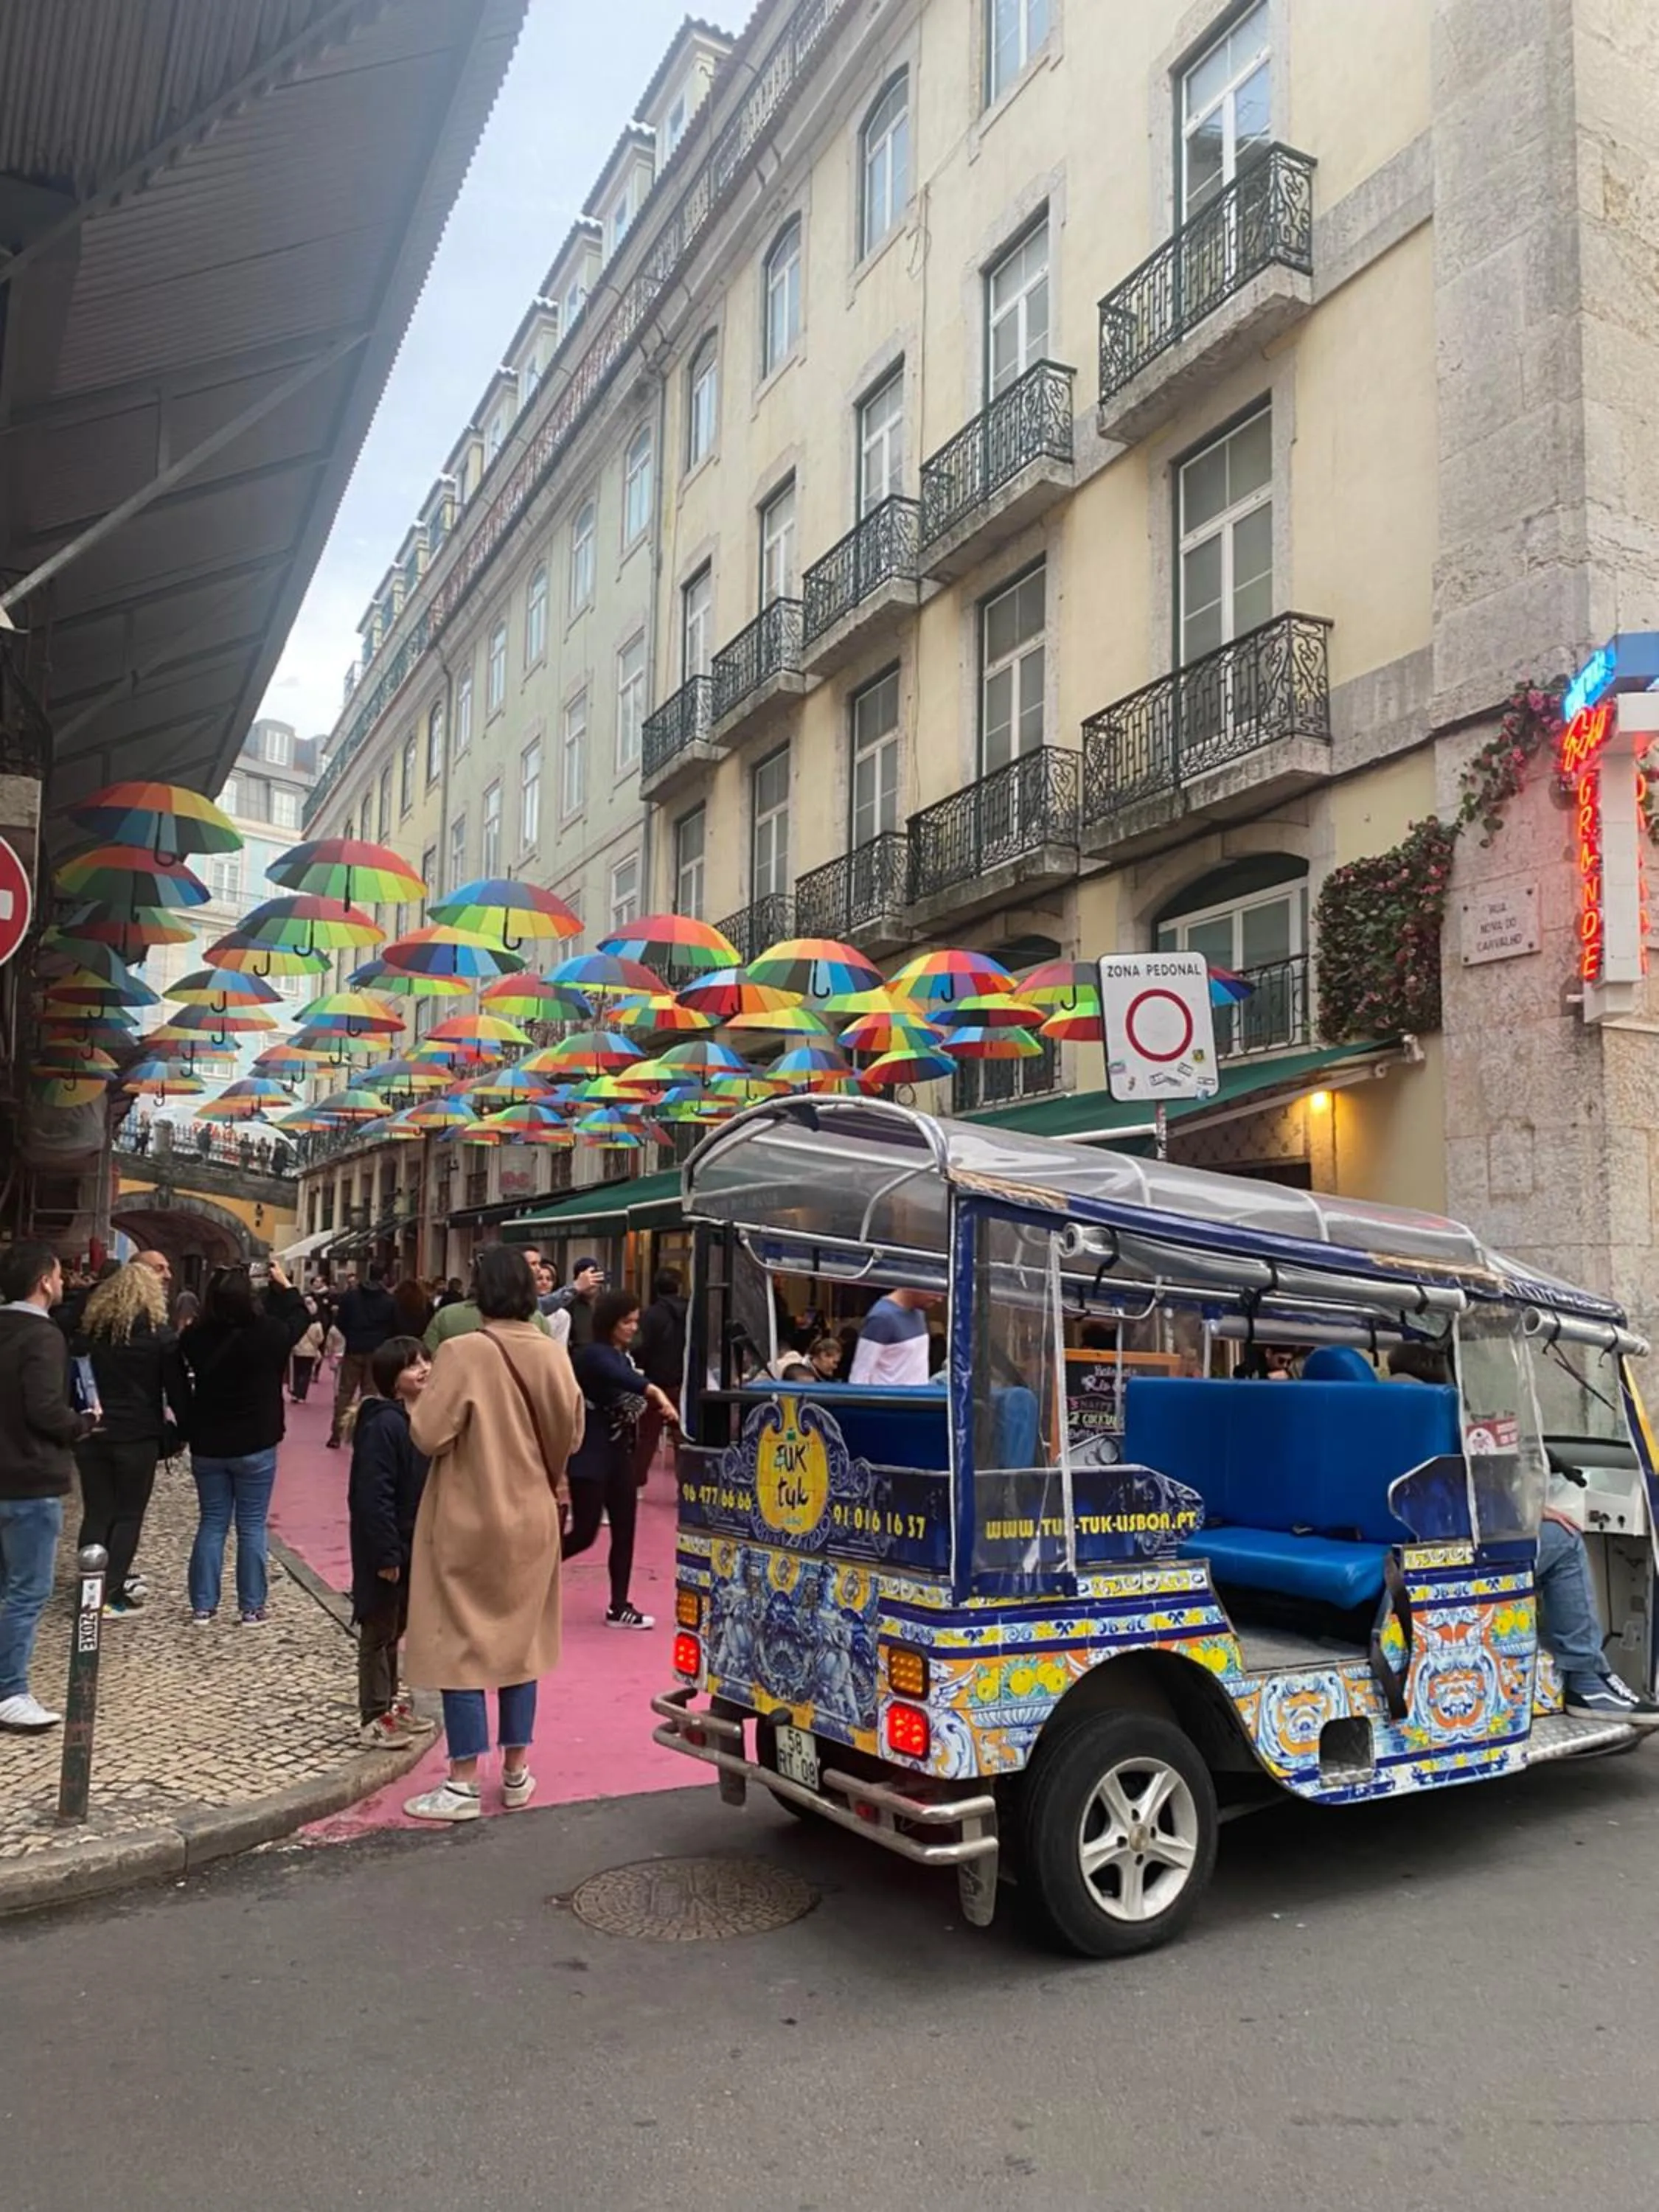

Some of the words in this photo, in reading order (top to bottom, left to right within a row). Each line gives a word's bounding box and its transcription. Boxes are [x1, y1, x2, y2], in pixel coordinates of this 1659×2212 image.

[1578, 773, 1600, 977] GRANDE
[1479, 920, 1503, 934] NOVA
[1505, 917, 1516, 930] DO
[1477, 932, 1523, 953] CARVALHO
[1107, 965, 1140, 978] ZONA
[1146, 964, 1202, 976] PEDONAL
[683, 1483, 696, 1503] 96
[698, 1485, 717, 1505] 477
[722, 1488, 735, 1509] 66
[737, 1491, 751, 1511] 66
[833, 1505, 849, 1527] 91
[855, 1506, 880, 1532] 016
[887, 1511, 903, 1536] 16
[908, 1514, 926, 1540] 37
[80, 1615, 96, 1649] ZOXE
[787, 1728, 802, 1755] 58
